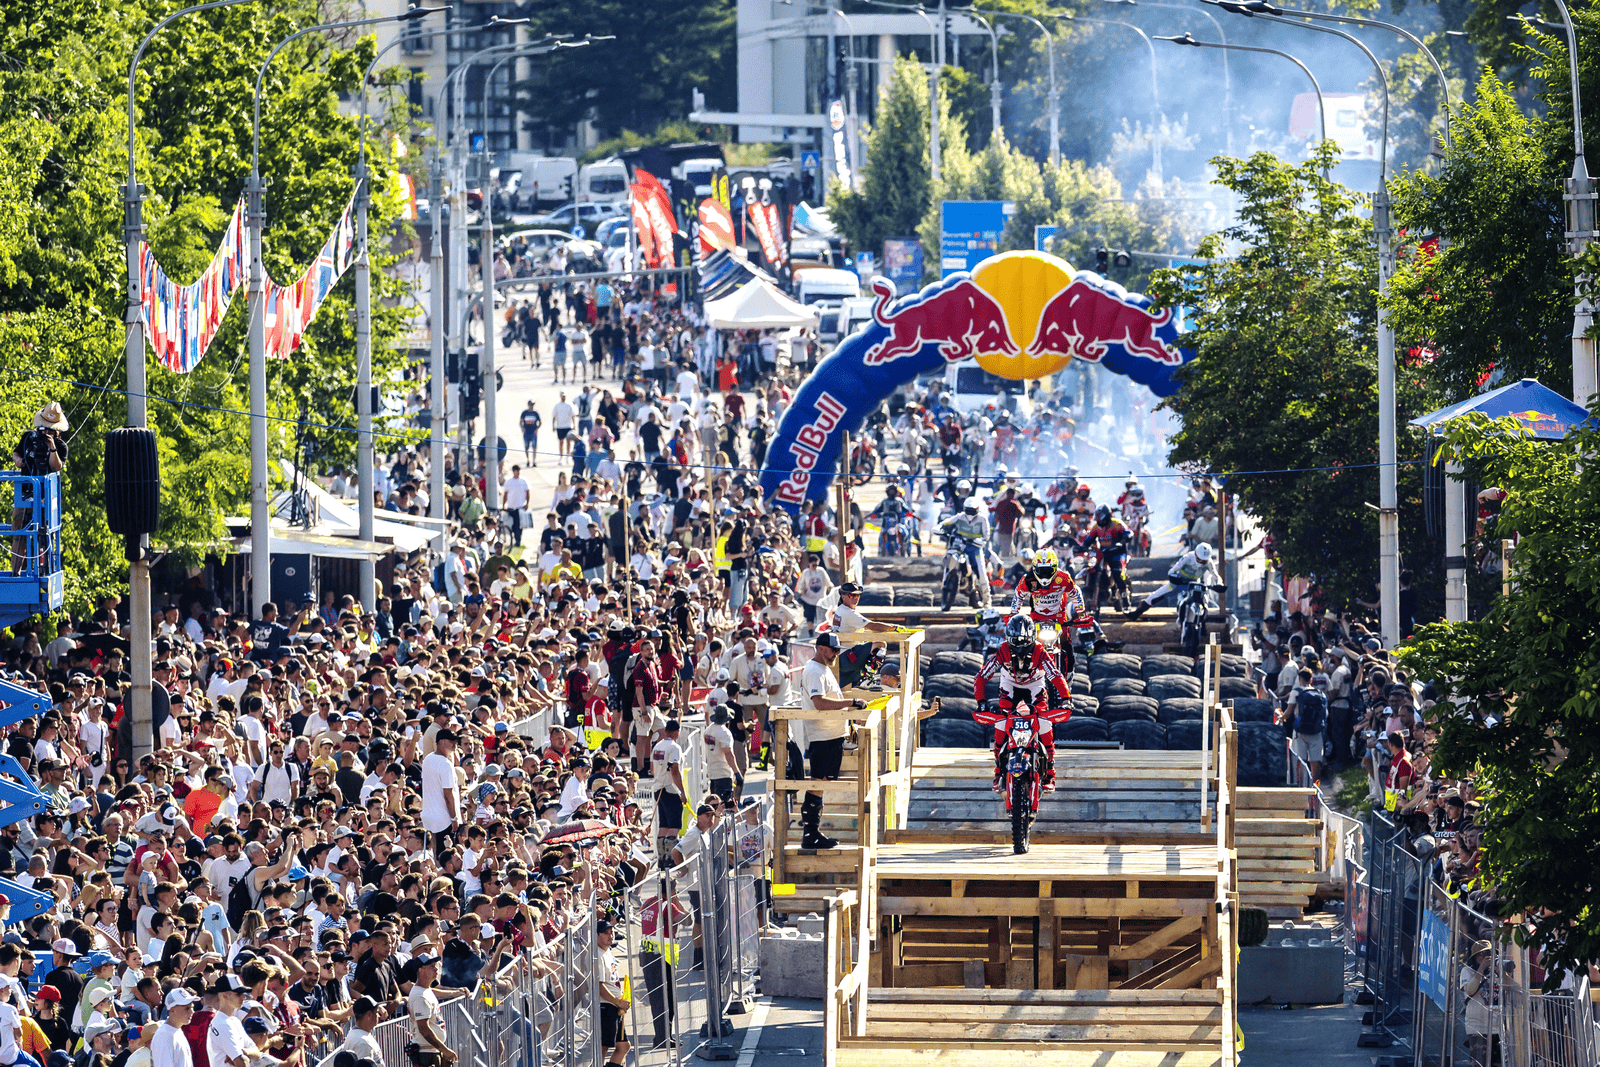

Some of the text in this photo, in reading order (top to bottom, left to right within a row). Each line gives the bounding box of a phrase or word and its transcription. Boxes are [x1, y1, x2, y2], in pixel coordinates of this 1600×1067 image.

[776, 391, 846, 504] Red Bull
[1014, 721, 1029, 729] 516
